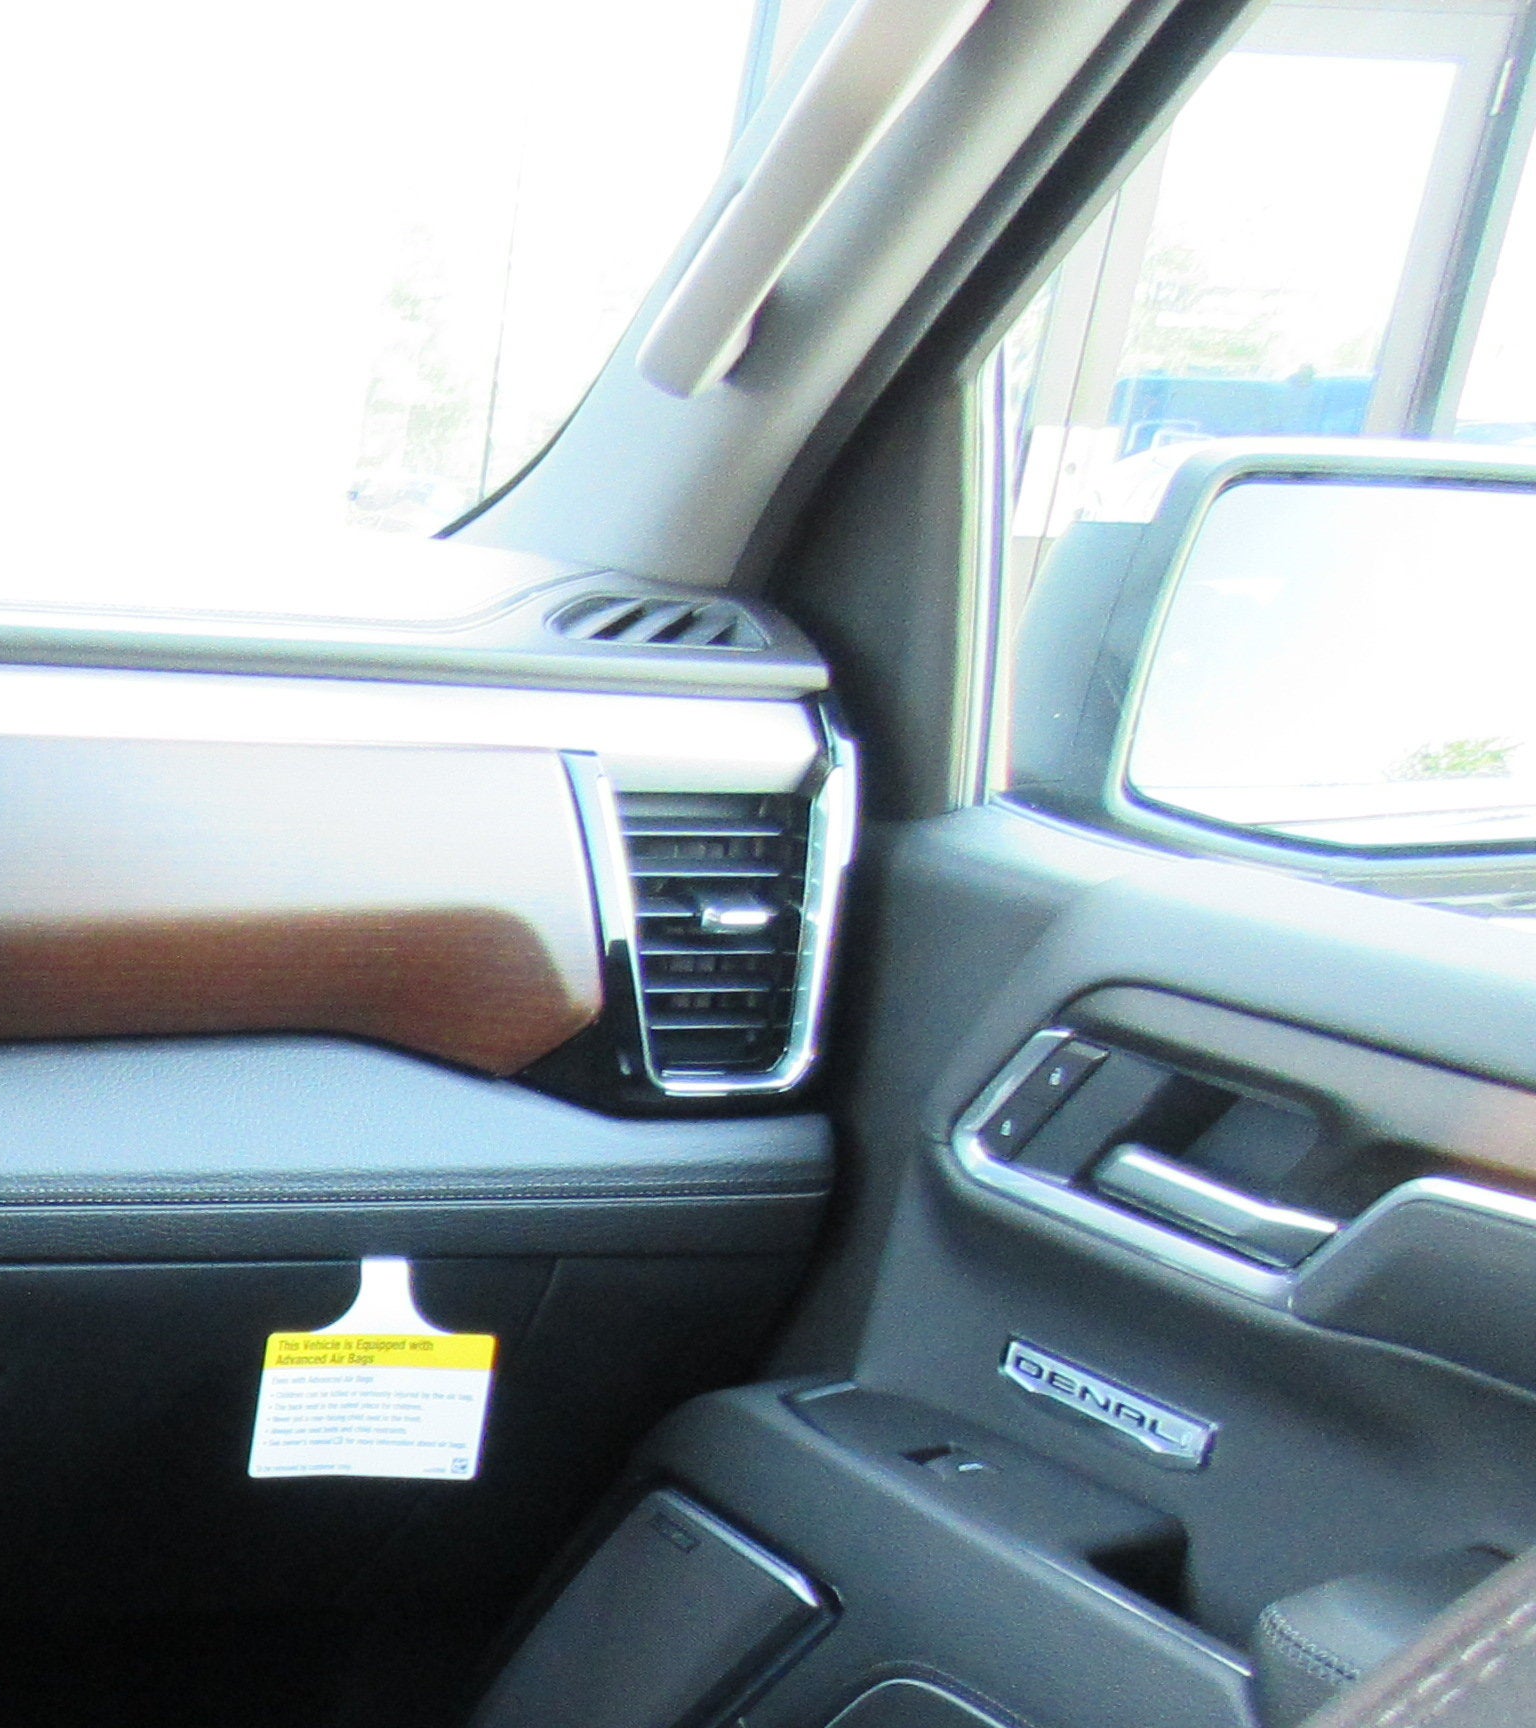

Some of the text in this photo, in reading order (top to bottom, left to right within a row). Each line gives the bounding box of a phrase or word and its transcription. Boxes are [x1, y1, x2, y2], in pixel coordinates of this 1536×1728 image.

[278, 1338, 434, 1352] This Vehicle is Equipped with
[275, 1353, 375, 1366] Advanced Air Bags
